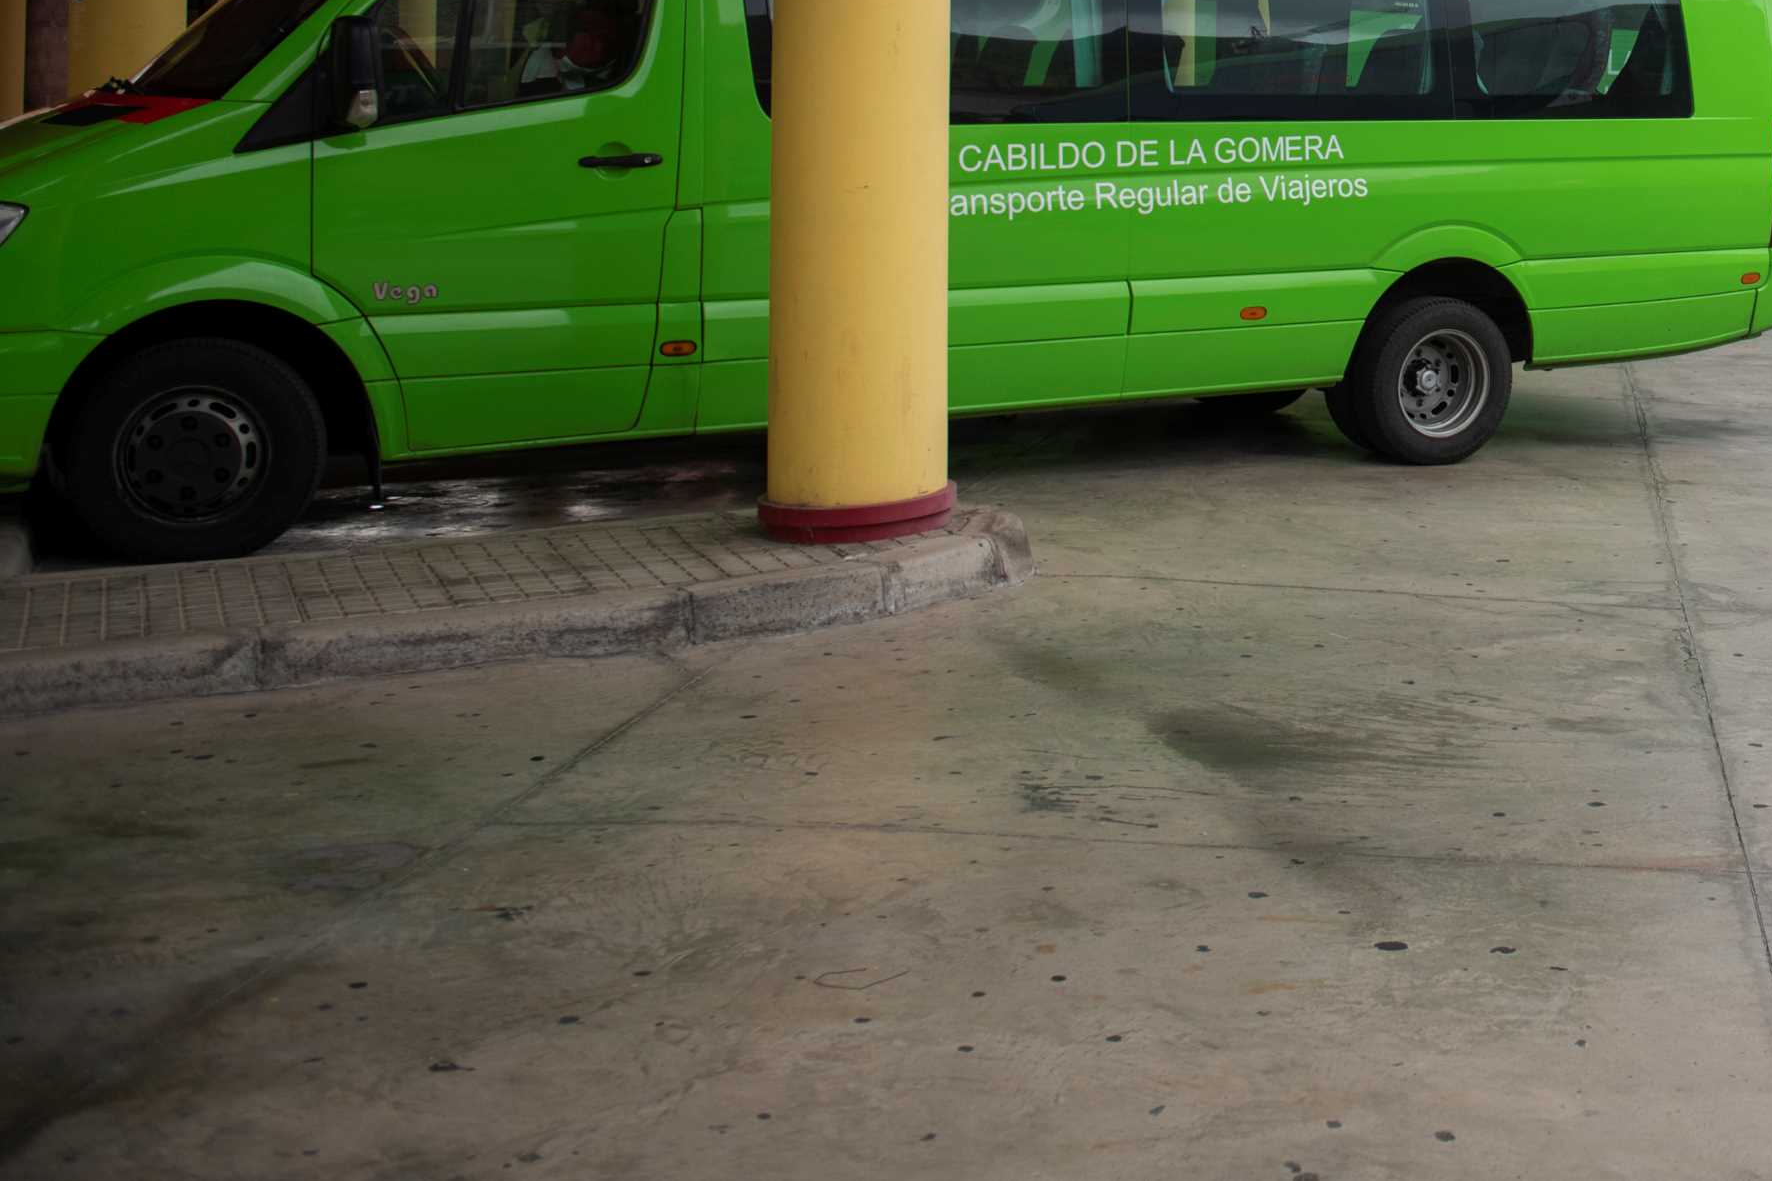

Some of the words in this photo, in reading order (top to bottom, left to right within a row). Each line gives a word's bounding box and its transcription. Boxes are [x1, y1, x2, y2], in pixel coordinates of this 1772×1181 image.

[958, 141, 1106, 172] CABILDO
[1116, 139, 1159, 167] DE
[1169, 138, 1208, 165] LA
[1214, 134, 1345, 164] GOMERA
[950, 184, 1085, 221] ansporte
[1095, 179, 1209, 215] Regular
[1217, 177, 1252, 204] de
[1258, 173, 1369, 206] Viajeros
[373, 282, 438, 305] Vega
